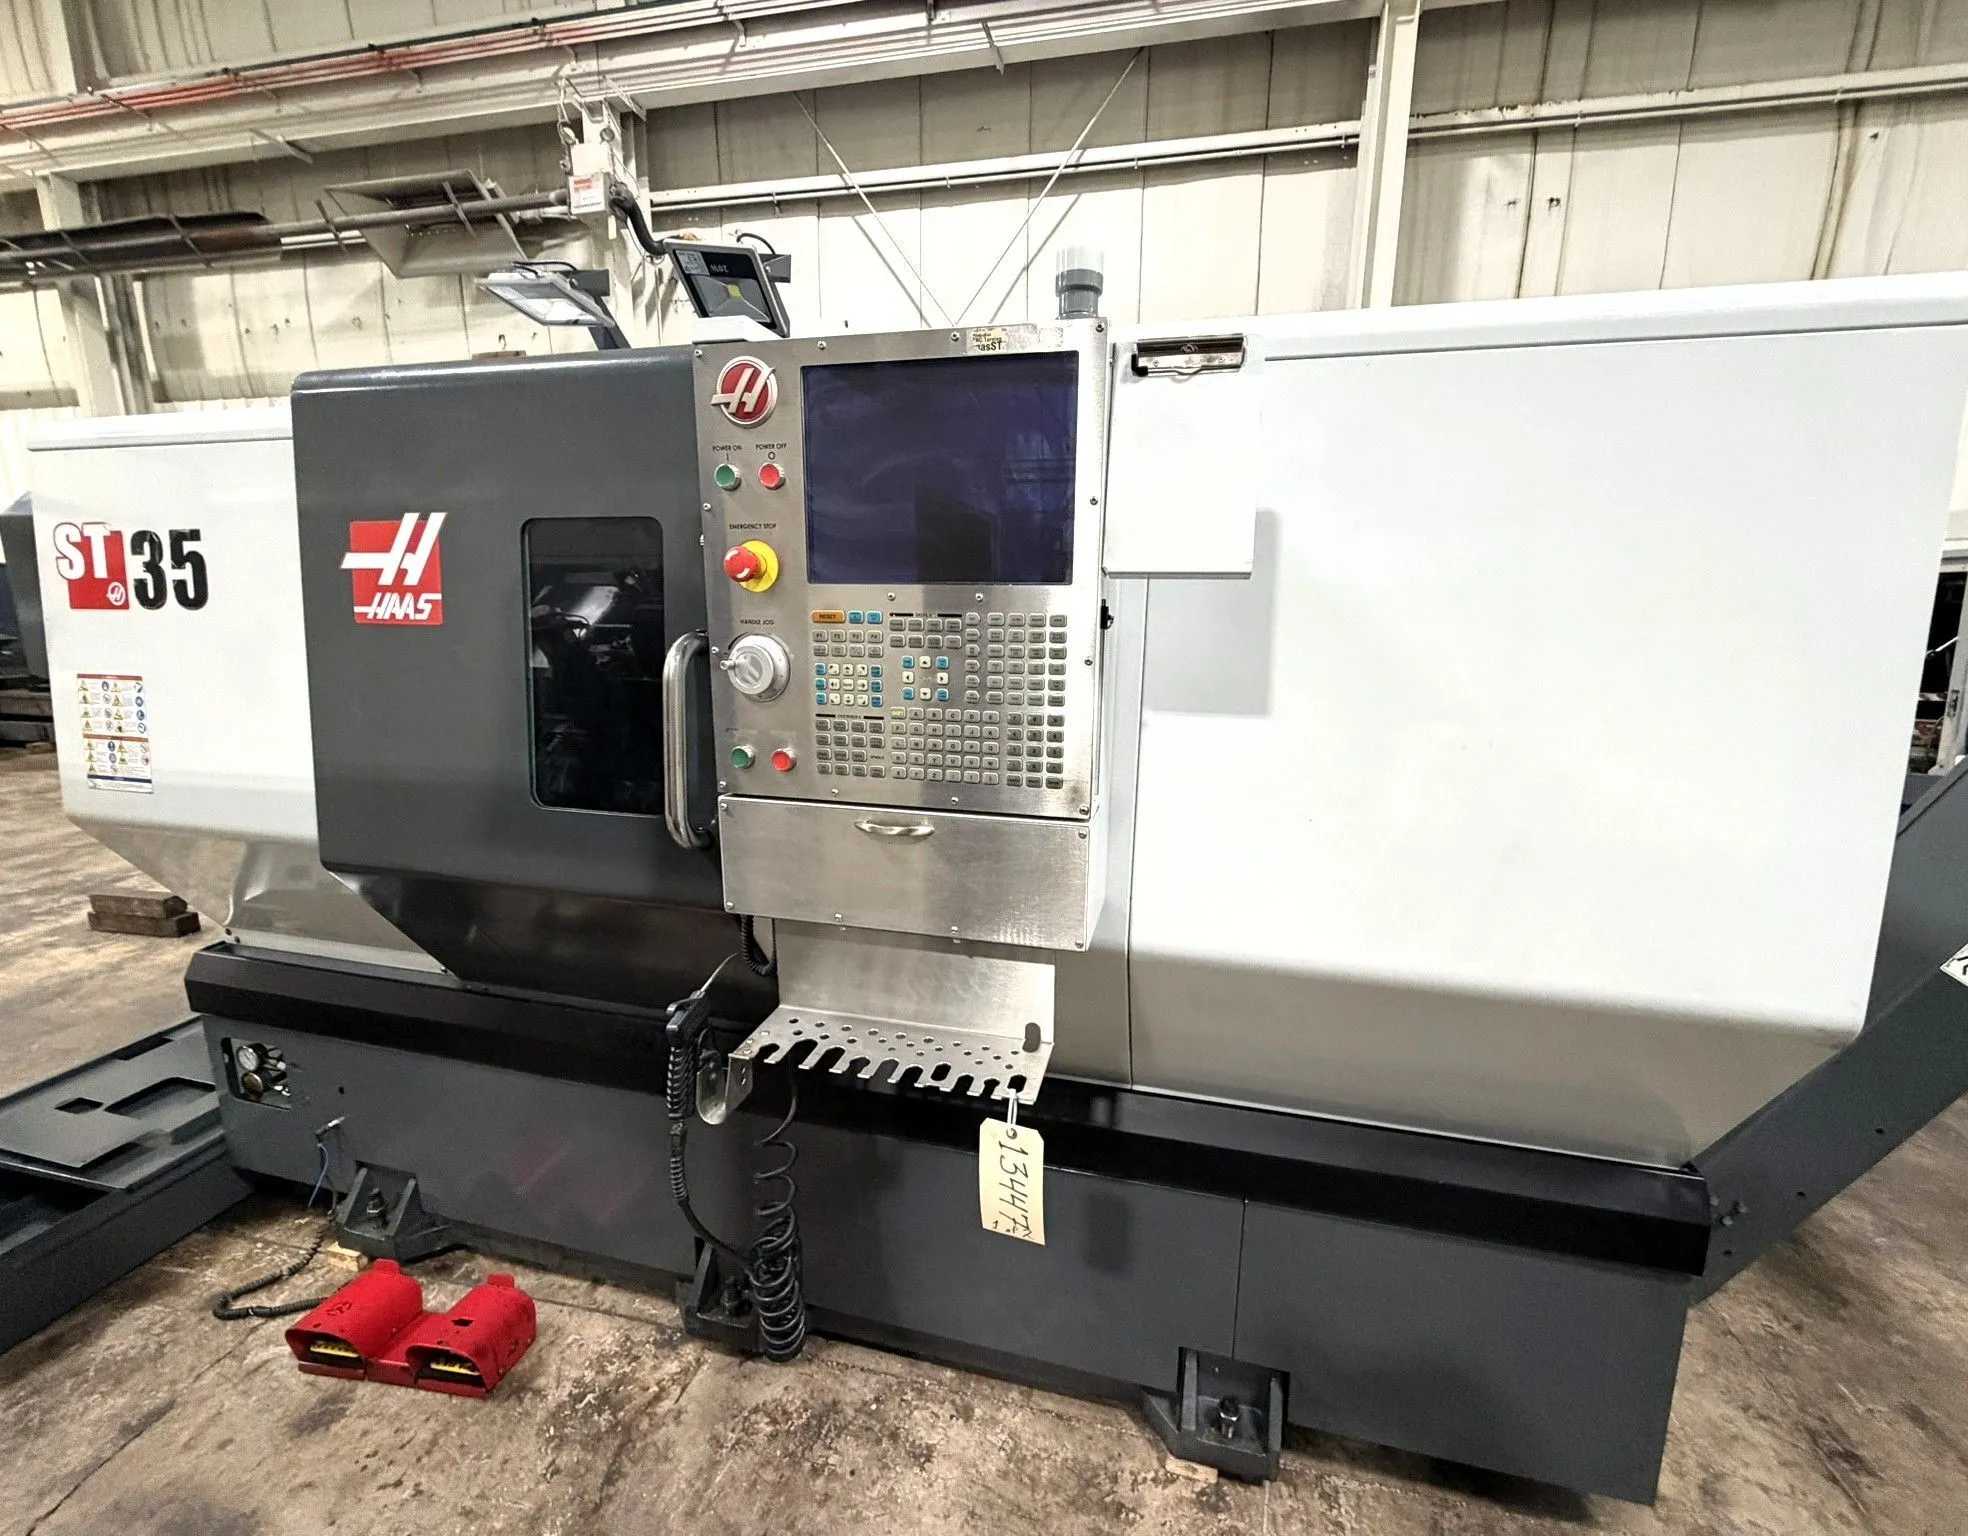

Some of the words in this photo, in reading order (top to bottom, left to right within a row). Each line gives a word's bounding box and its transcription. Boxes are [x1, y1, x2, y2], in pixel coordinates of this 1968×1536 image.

[712, 444, 731, 452] POWER
[53, 522, 111, 580] ST
[130, 529, 209, 611] 35
[353, 592, 442, 621] HAAS
[998, 1140, 1030, 1231] 13447
